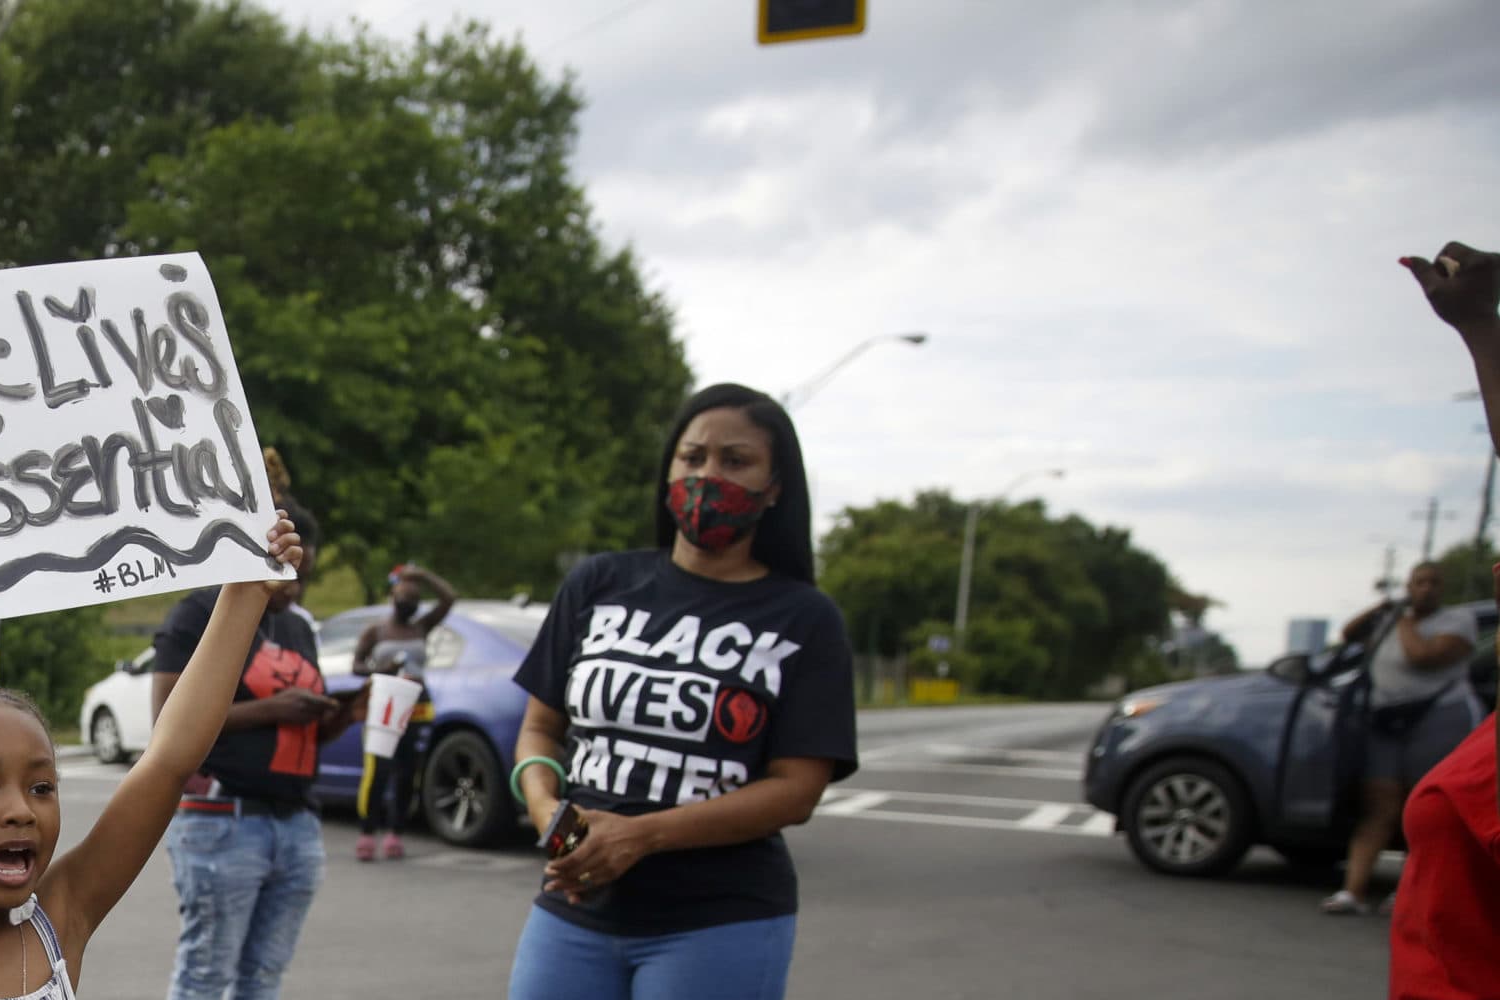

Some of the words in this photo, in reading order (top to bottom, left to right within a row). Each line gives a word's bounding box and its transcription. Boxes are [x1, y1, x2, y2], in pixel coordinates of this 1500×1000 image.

[93, 556, 176, 593] #BLM
[582, 604, 801, 697] BLACK
[569, 666, 712, 732] IVES
